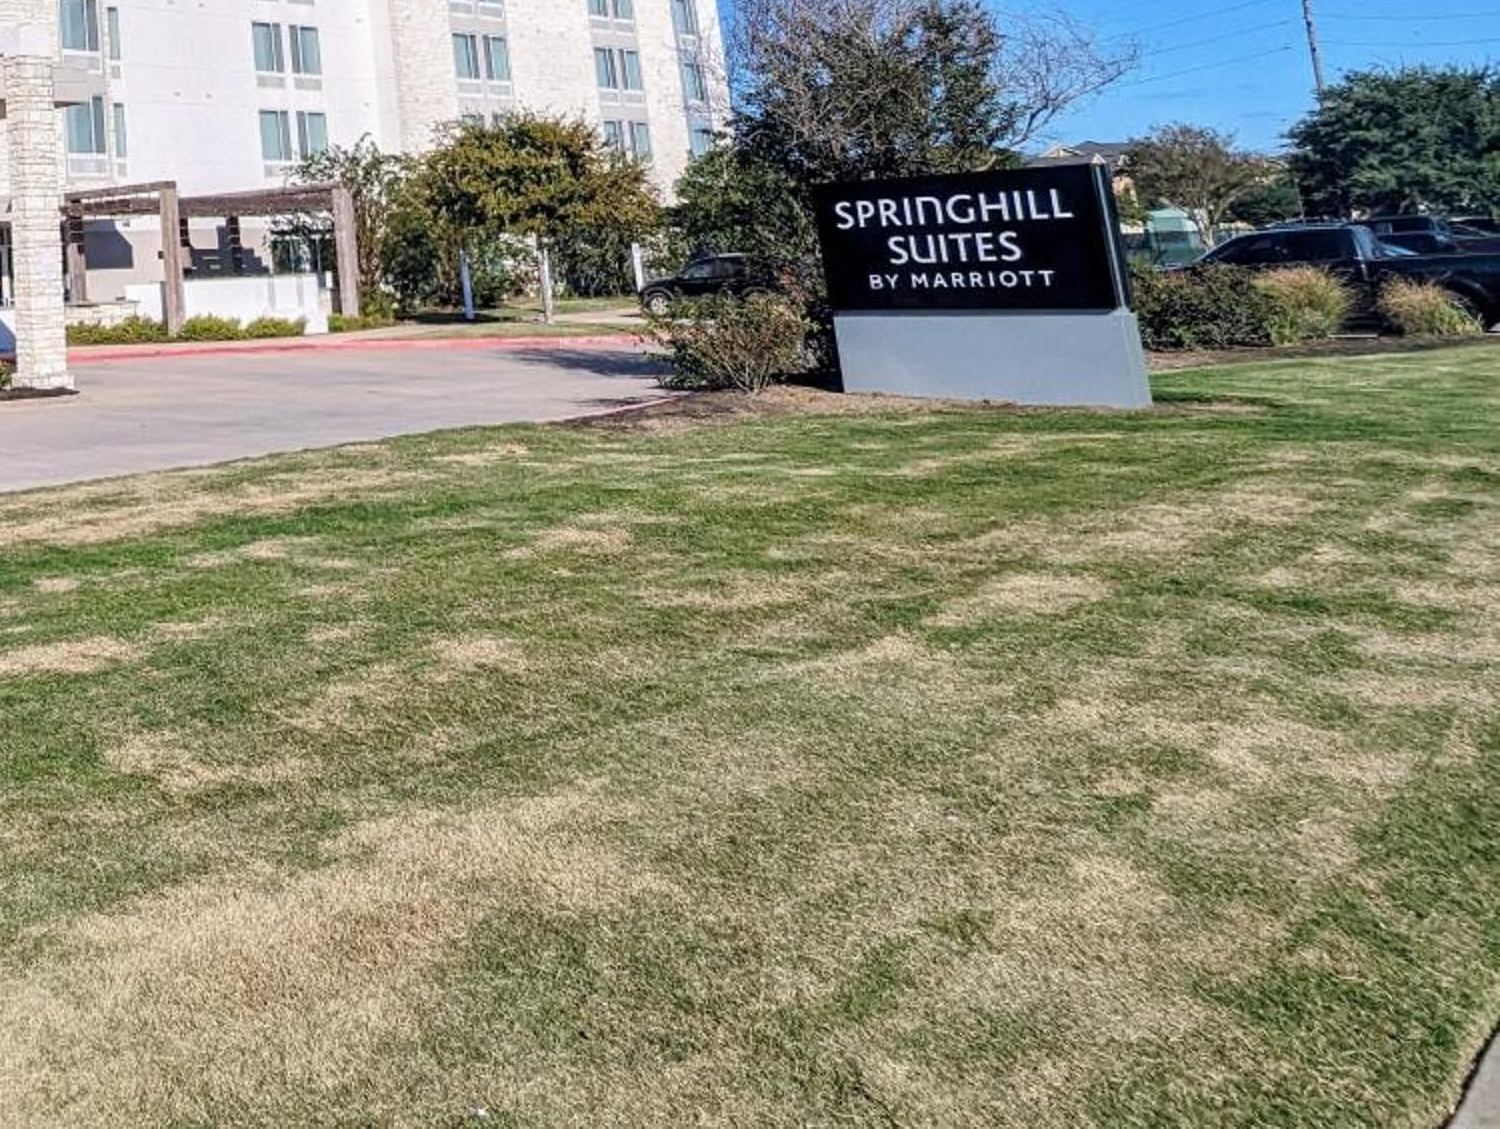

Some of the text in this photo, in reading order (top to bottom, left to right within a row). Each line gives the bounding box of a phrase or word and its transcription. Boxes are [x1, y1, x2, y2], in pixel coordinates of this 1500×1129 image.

[834, 188, 1074, 230] SPRINGHILL
[887, 231, 1023, 265] SUITES
[869, 270, 1056, 290] BY MARRIOTT
